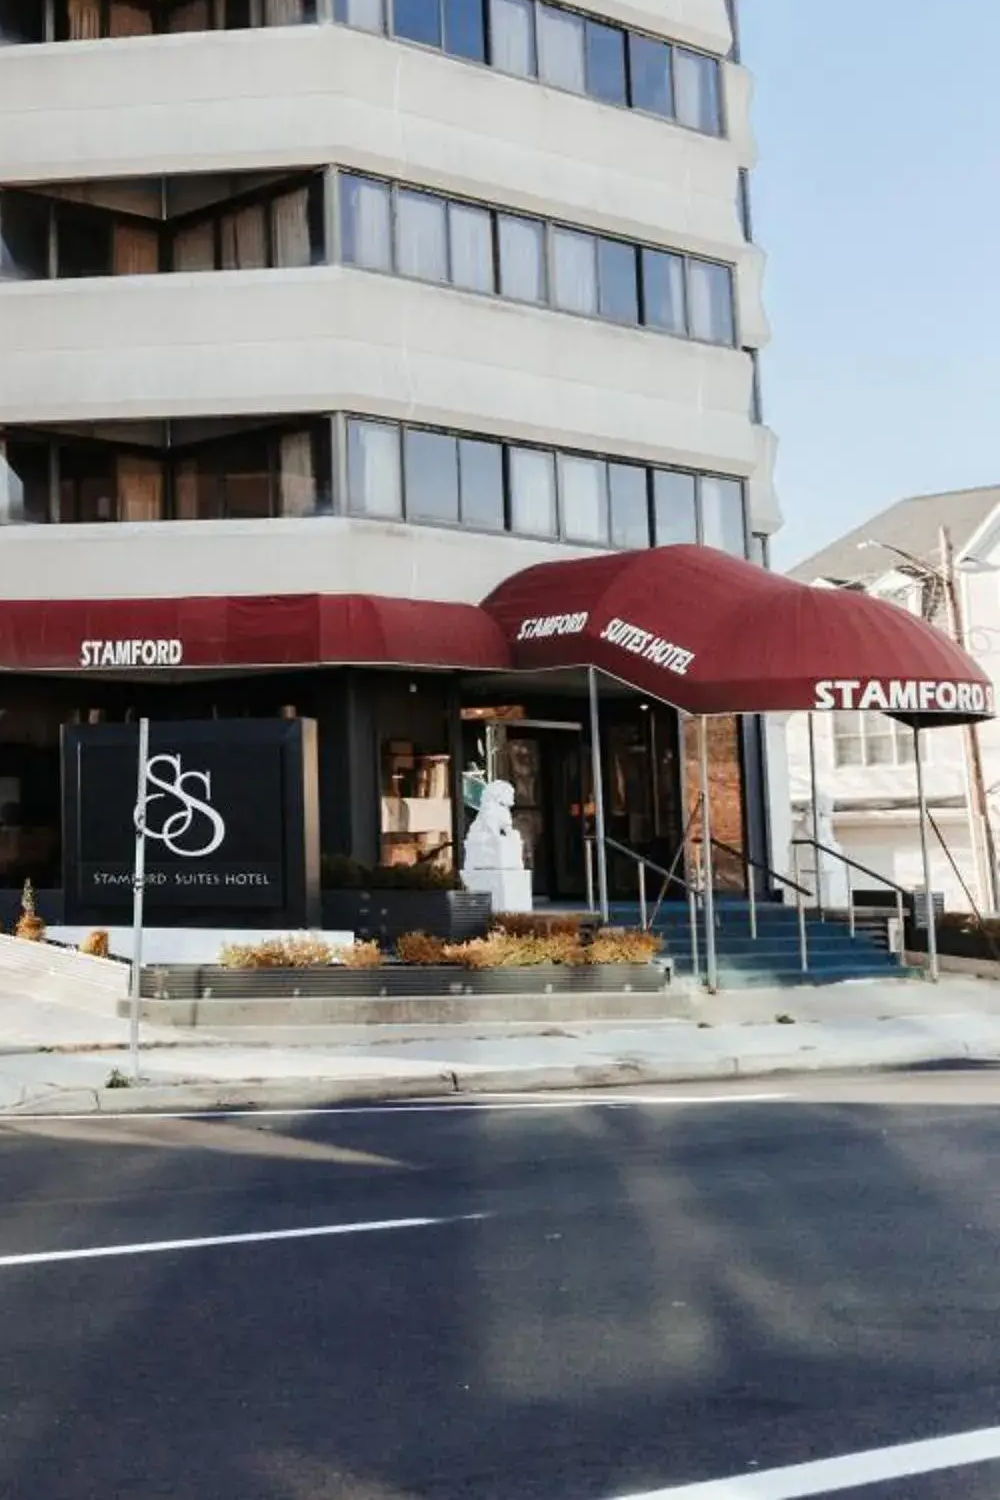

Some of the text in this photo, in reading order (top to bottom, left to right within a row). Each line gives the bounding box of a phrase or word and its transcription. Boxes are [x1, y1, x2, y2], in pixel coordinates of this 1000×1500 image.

[517, 612, 588, 640] STAMFORD
[80, 639, 183, 666] STAMFORD
[600, 617, 696, 676] SUITES HOTEL
[815, 679, 984, 711] STAMFORD
[93, 872, 270, 885] STAMRD SUITES HOTEL
